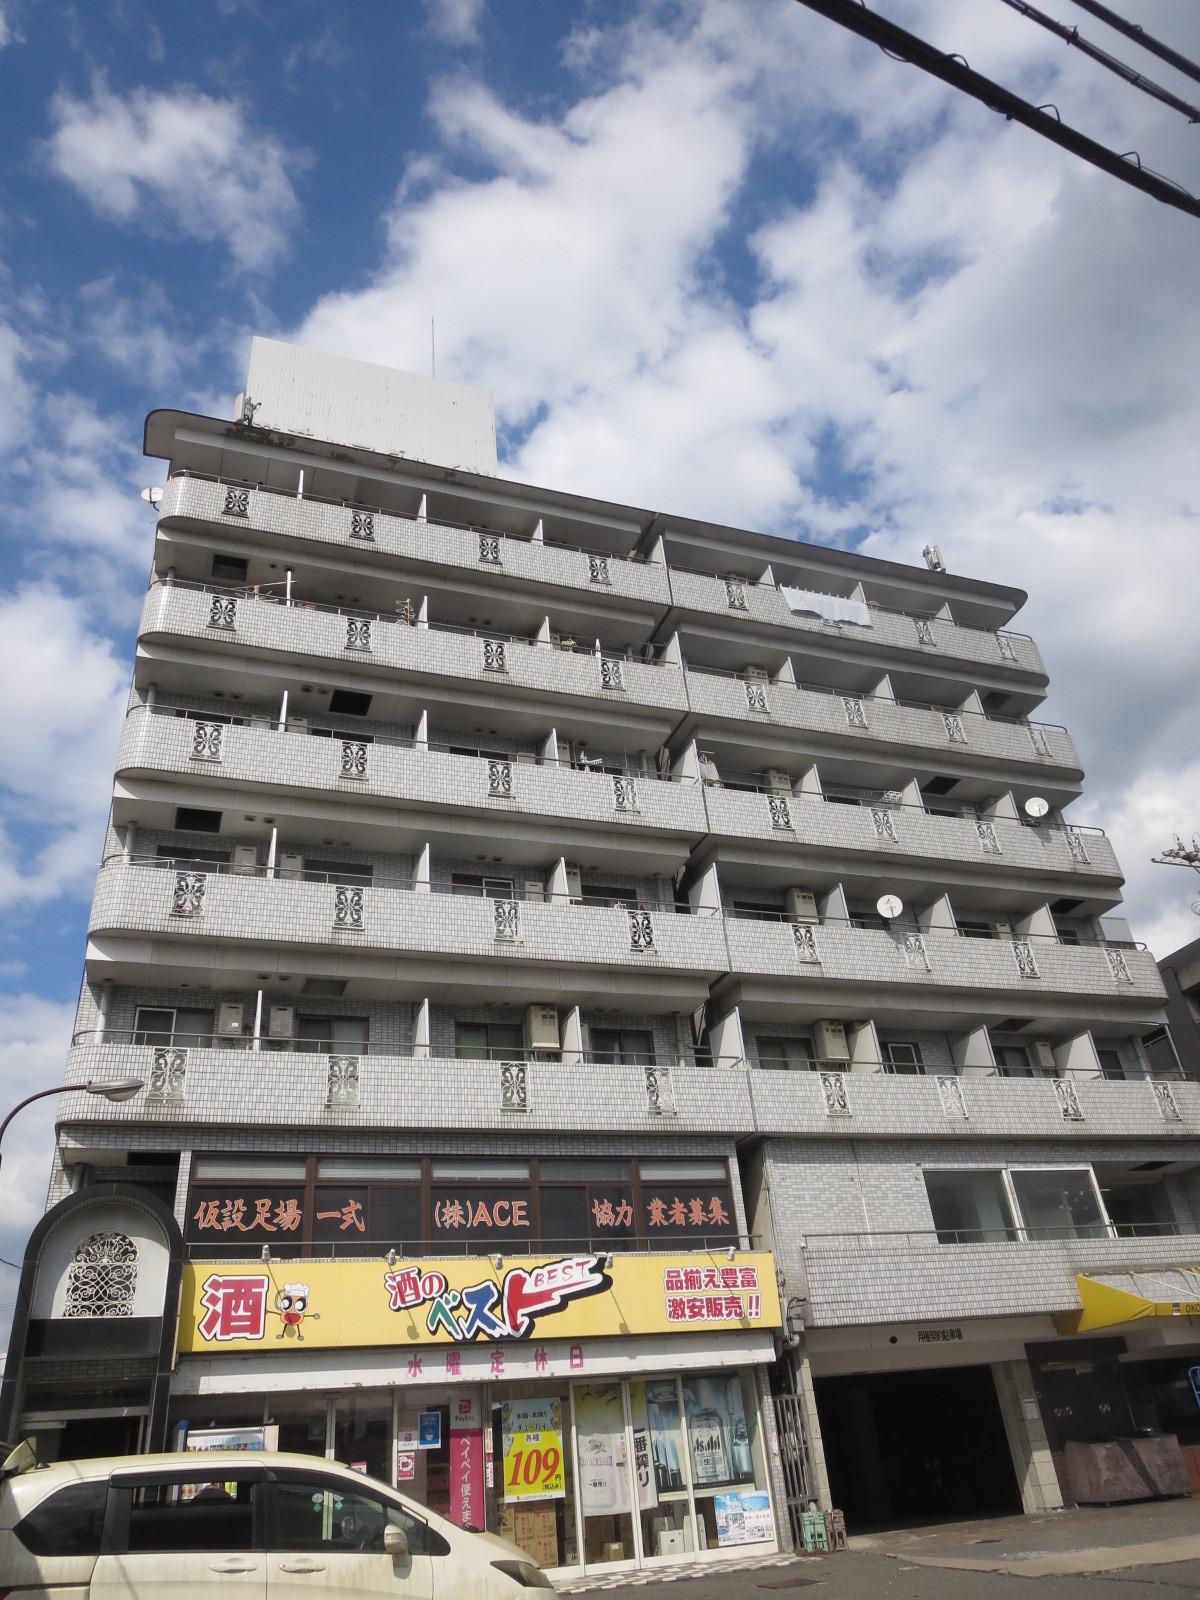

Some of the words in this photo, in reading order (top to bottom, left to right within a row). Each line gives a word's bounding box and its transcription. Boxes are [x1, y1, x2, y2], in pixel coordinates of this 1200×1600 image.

[193, 1199, 302, 1231] 仮設足場
[317, 1199, 366, 1232] 一式
[592, 1198, 633, 1228] 協力
[646, 1196, 730, 1227] 業者募集
[386, 1268, 444, 1308] 酒の
[534, 1261, 591, 1287] BEST
[666, 1267, 757, 1291] 品揃え豊富
[201, 1276, 267, 1339] 酒
[427, 1271, 596, 1339] ベスト
[408, 1345, 584, 1377] 水曜定休日
[633, 1428, 650, 1487] 一番搾り
[694, 1436, 721, 1453] Asahi
[508, 1448, 560, 1487] 109
